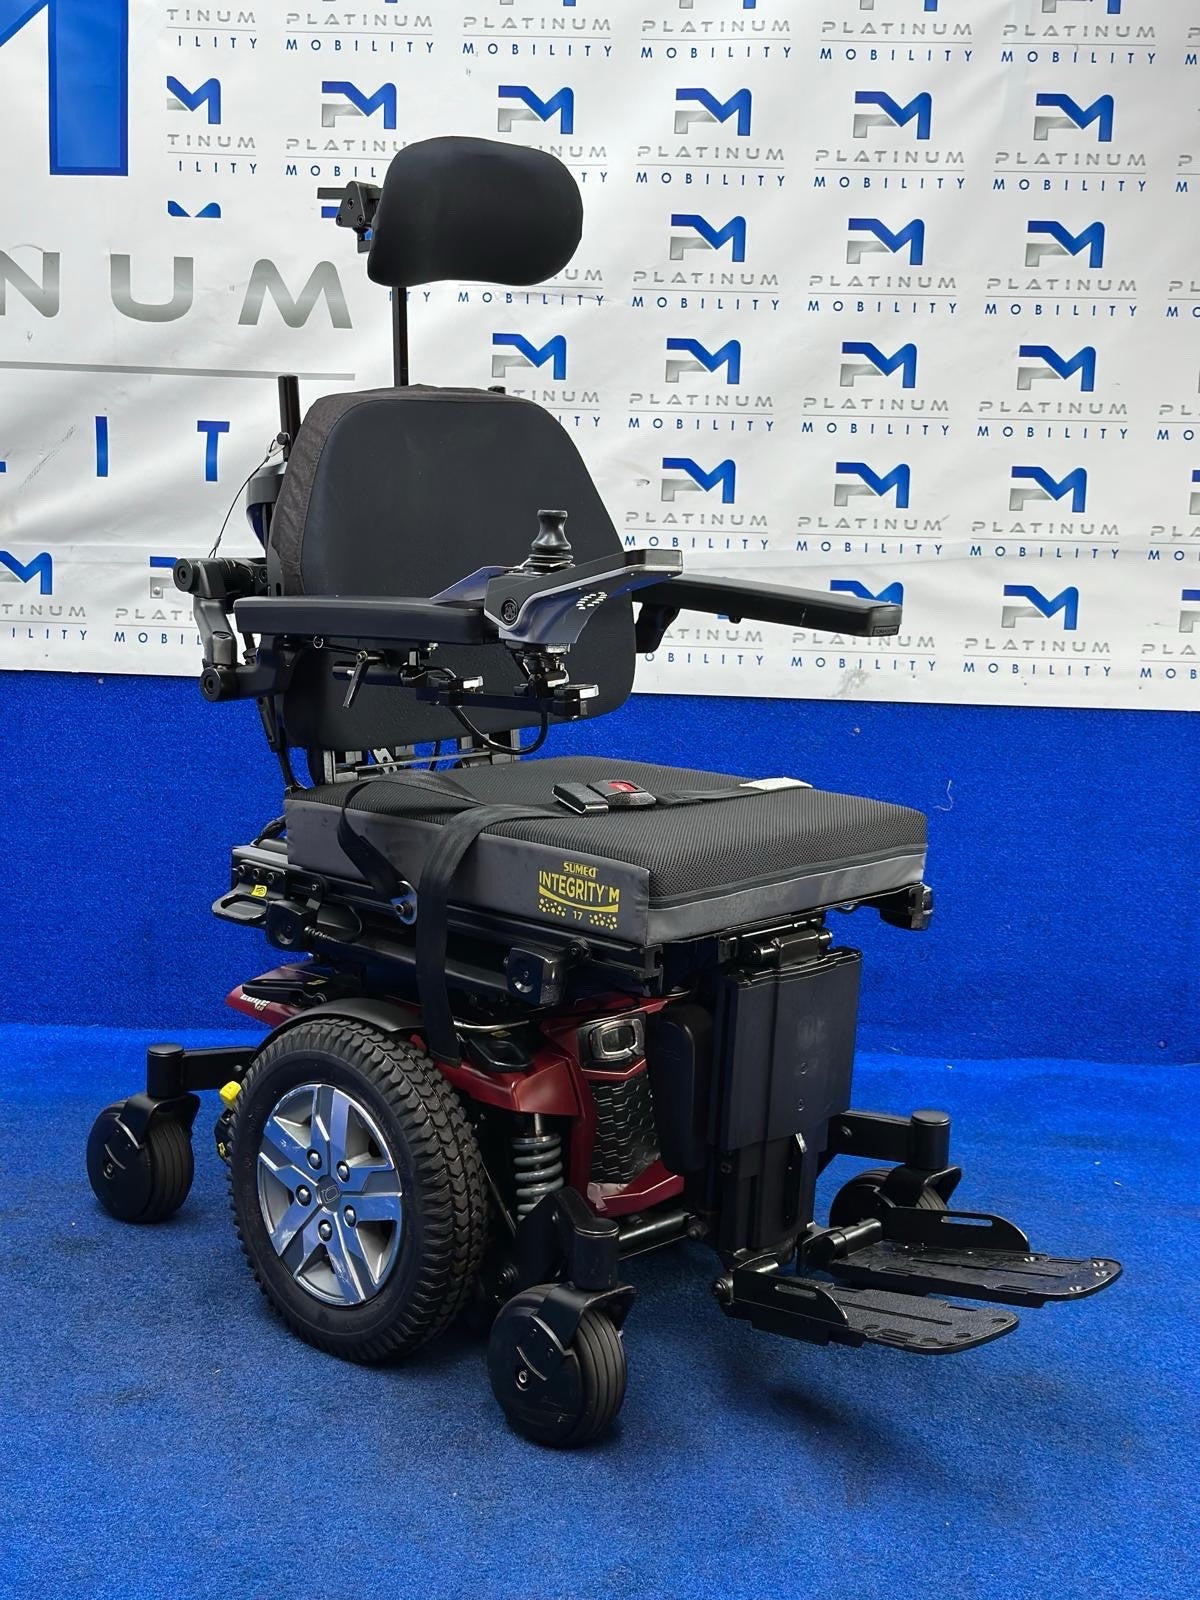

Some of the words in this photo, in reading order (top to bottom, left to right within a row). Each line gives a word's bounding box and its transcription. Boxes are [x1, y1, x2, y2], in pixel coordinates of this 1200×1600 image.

[287, 13, 432, 27] PLATINUM
[463, 16, 611, 31] PLATINUM
[641, 20, 790, 33] PLATINUM
[822, 21, 972, 35] PLATINUM
[1003, 24, 1156, 38] PLATINUM
[286, 39, 434, 53] MOBILITY
[462, 42, 612, 57] MOBILITY
[640, 46, 791, 59] MOBILITY
[820, 48, 973, 62] MOBILITY
[1001, 50, 1156, 65] MOBILITY
[638, 146, 784, 161] PLATINUM
[815, 150, 964, 163] PLATINUM
[995, 152, 1146, 166] PLATINUM
[636, 172, 785, 187] MOBILITY
[813, 176, 965, 189] MOBILITY
[993, 178, 1146, 192] MOBILITY
[633, 271, 778, 286] PLATINUM
[809, 275, 956, 289] PLATINUM
[987, 278, 1137, 291] PLATINUM
[458, 292, 605, 306] MOBILITY
[631, 296, 779, 310] MOBILITY
[808, 300, 957, 314] MOBILITY
[985, 303, 1137, 317] MOBILITY
[629, 393, 773, 408] PLATINUM
[803, 397, 949, 411] PLATINUM
[979, 401, 1127, 415] PLATINUM
[628, 417, 774, 432] MOBILITY
[801, 422, 949, 436] MOBILITY
[977, 426, 1128, 439] MOBILITY
[626, 511, 768, 526] PLATINUM
[797, 516, 942, 531] PLATINUM
[972, 521, 1119, 535] PLATINUM
[624, 536, 768, 550] MOBILITY
[796, 540, 943, 555] MOBILITY
[969, 545, 1120, 559] MOBILITY
[965, 638, 1110, 653] PLATINUM
[791, 657, 936, 672] MOBILITY
[963, 662, 1111, 677] MOBILITY
[572, 911, 583, 921] 17
